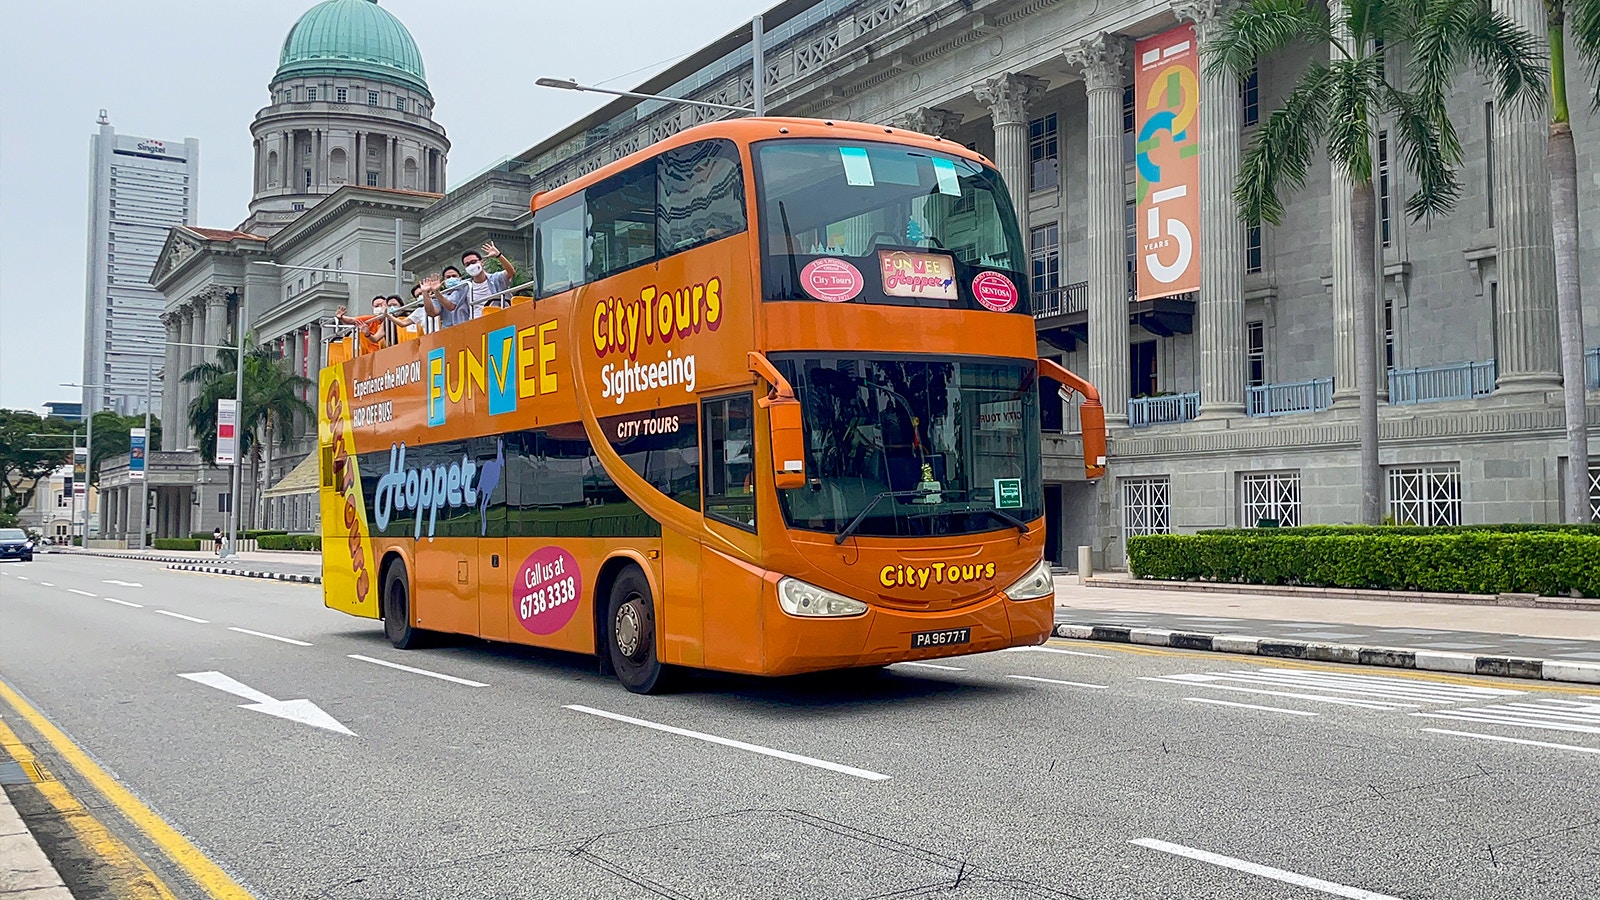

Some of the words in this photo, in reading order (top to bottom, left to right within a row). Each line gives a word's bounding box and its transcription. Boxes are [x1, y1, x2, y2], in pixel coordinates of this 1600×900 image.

[137, 142, 166, 153] Singtel
[1144, 240, 1169, 251] YEARS
[884, 258, 941, 274] FUNVEE
[813, 275, 829, 285] City
[830, 276, 851, 284] Tours
[887, 269, 942, 292] Hopper
[981, 287, 1010, 298] SENTOSA
[593, 277, 721, 360] CityTours
[353, 376, 384, 401] Experience
[384, 369, 395, 390] the
[395, 364, 409, 387] HOP
[410, 361, 421, 383] ON
[429, 319, 558, 419] FUNVEE
[601, 350, 695, 404] Sightseeing
[354, 408, 366, 428] HOP
[366, 404, 378, 425] OFF
[378, 401, 393, 423] BUS!
[617, 420, 642, 438] CITY
[643, 415, 679, 436] TOURS
[374, 441, 479, 542] Hopper
[525, 562, 542, 589] Call
[542, 562, 554, 582] us
[554, 555, 565, 576] at
[520, 589, 547, 620] 6738
[547, 576, 576, 609] 3338
